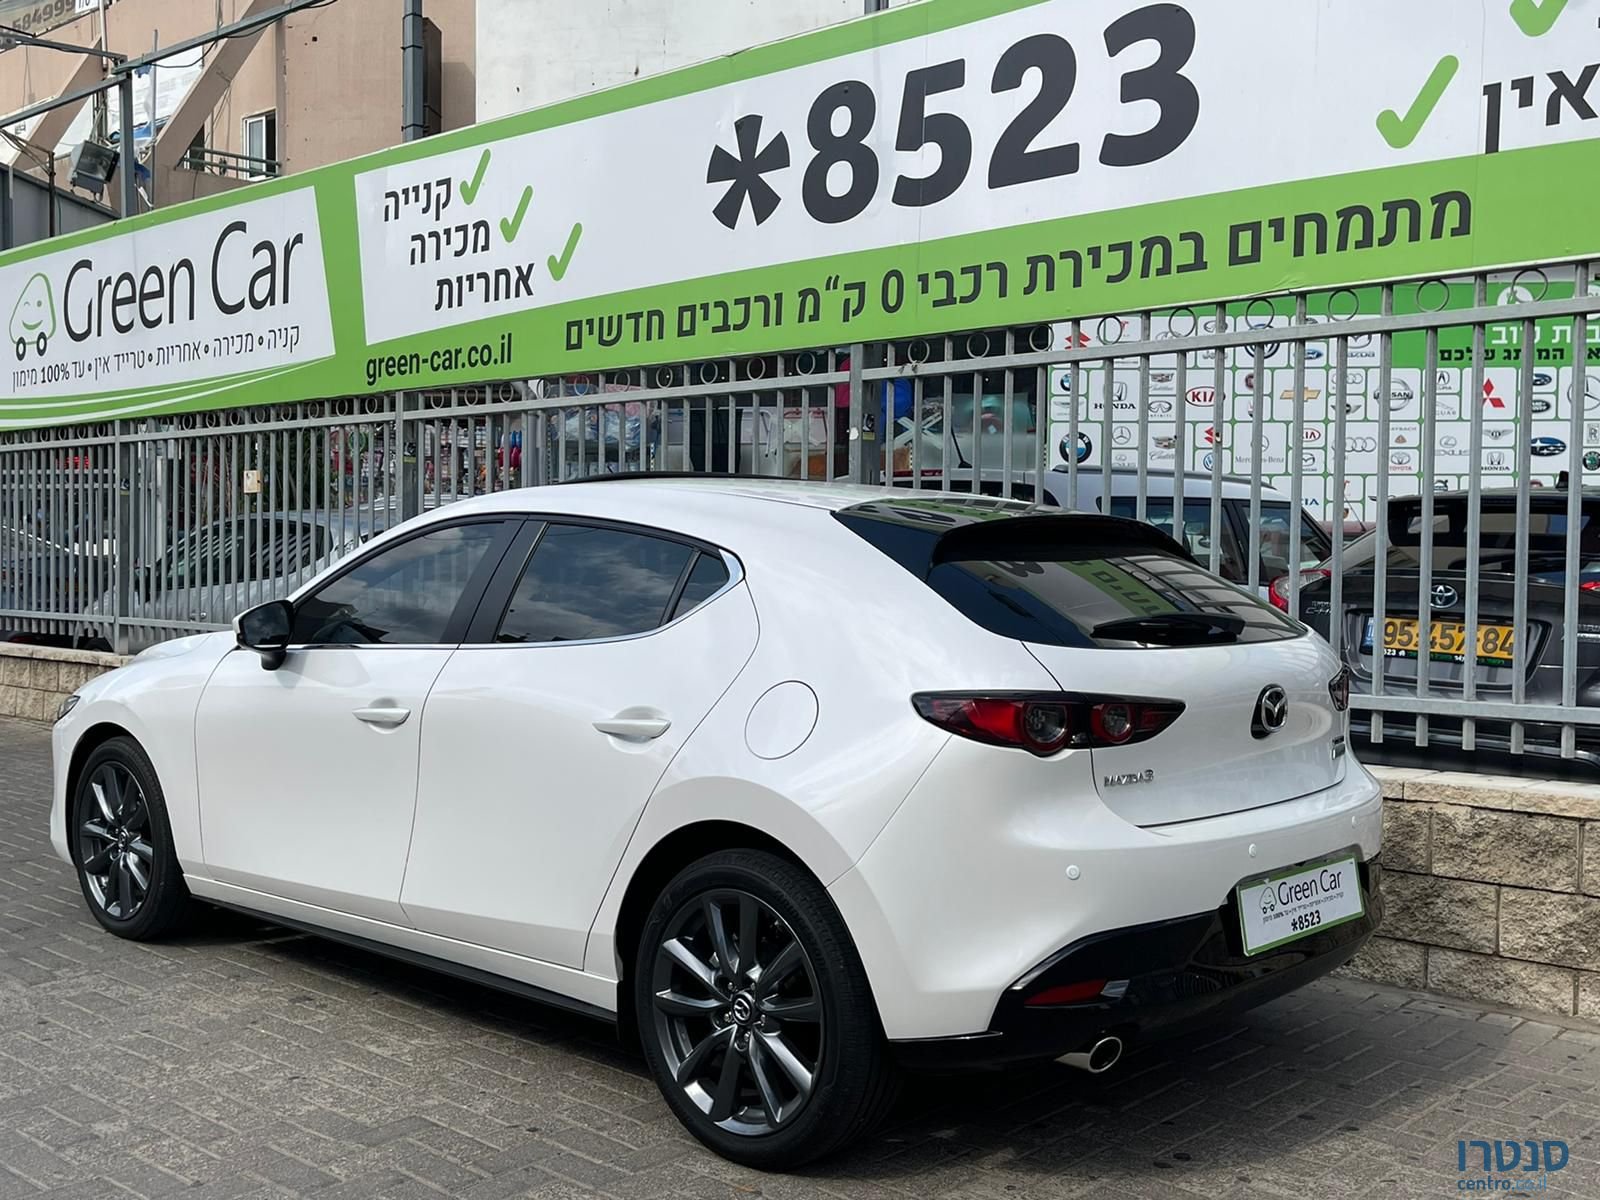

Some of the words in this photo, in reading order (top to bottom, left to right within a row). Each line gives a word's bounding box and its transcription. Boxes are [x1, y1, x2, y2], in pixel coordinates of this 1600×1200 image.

[1483, 63, 1600, 155] אין
[384, 177, 452, 222] קנייה
[410, 219, 491, 265] מכירה
[1228, 190, 1472, 266] מתמחים
[63, 259, 196, 342] Green
[211, 220, 303, 315] Car
[917, 261, 1007, 308] רכבי
[1023, 231, 1208, 296] במכירת
[434, 263, 535, 311] אחריות
[881, 269, 905, 314] 0
[566, 309, 664, 351] חדשים
[677, 292, 783, 338] ורכבים
[113, 350, 145, 372] טרייד
[155, 341, 201, 366] אחריות
[213, 332, 254, 358] מכירה
[267, 325, 300, 354] קניה
[366, 333, 512, 386] green-car.co.il
[12, 367, 38, 393] מימון
[41, 363, 70, 384] 100%
[71, 359, 85, 379] עד
[94, 354, 110, 381] אין
[1094, 402, 1136, 410] HNDA
[1278, 878, 1318, 906] Green
[1320, 869, 1342, 893] Car
